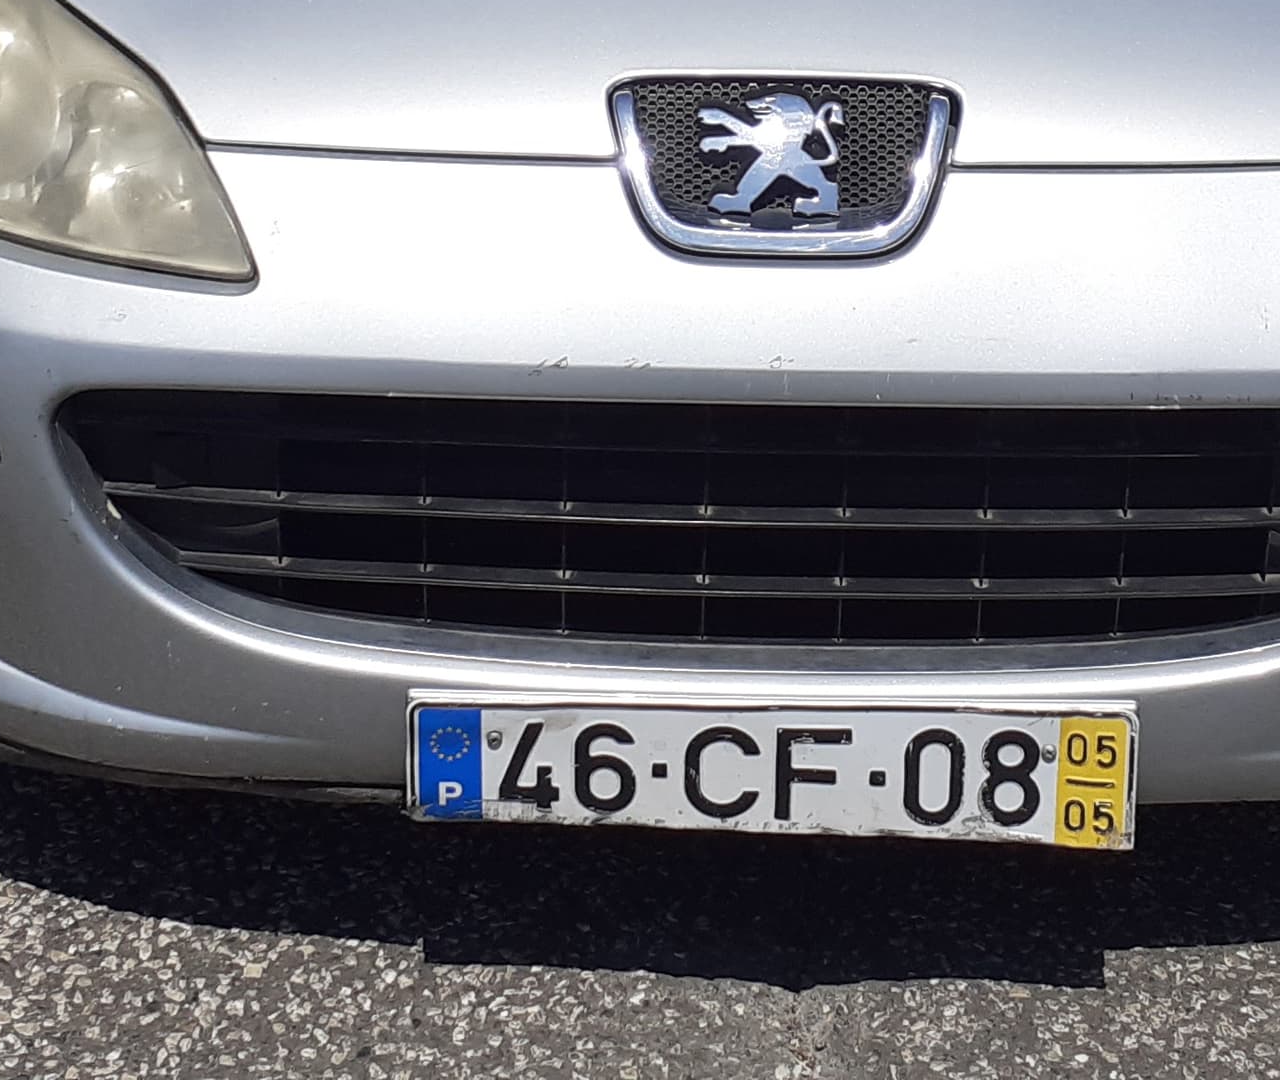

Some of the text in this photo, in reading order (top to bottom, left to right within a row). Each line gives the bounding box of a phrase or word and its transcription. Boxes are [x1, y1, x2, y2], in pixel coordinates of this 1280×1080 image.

[1066, 732, 1117, 769] 05
[438, 781, 462, 806] P
[1063, 799, 1114, 835] 05
